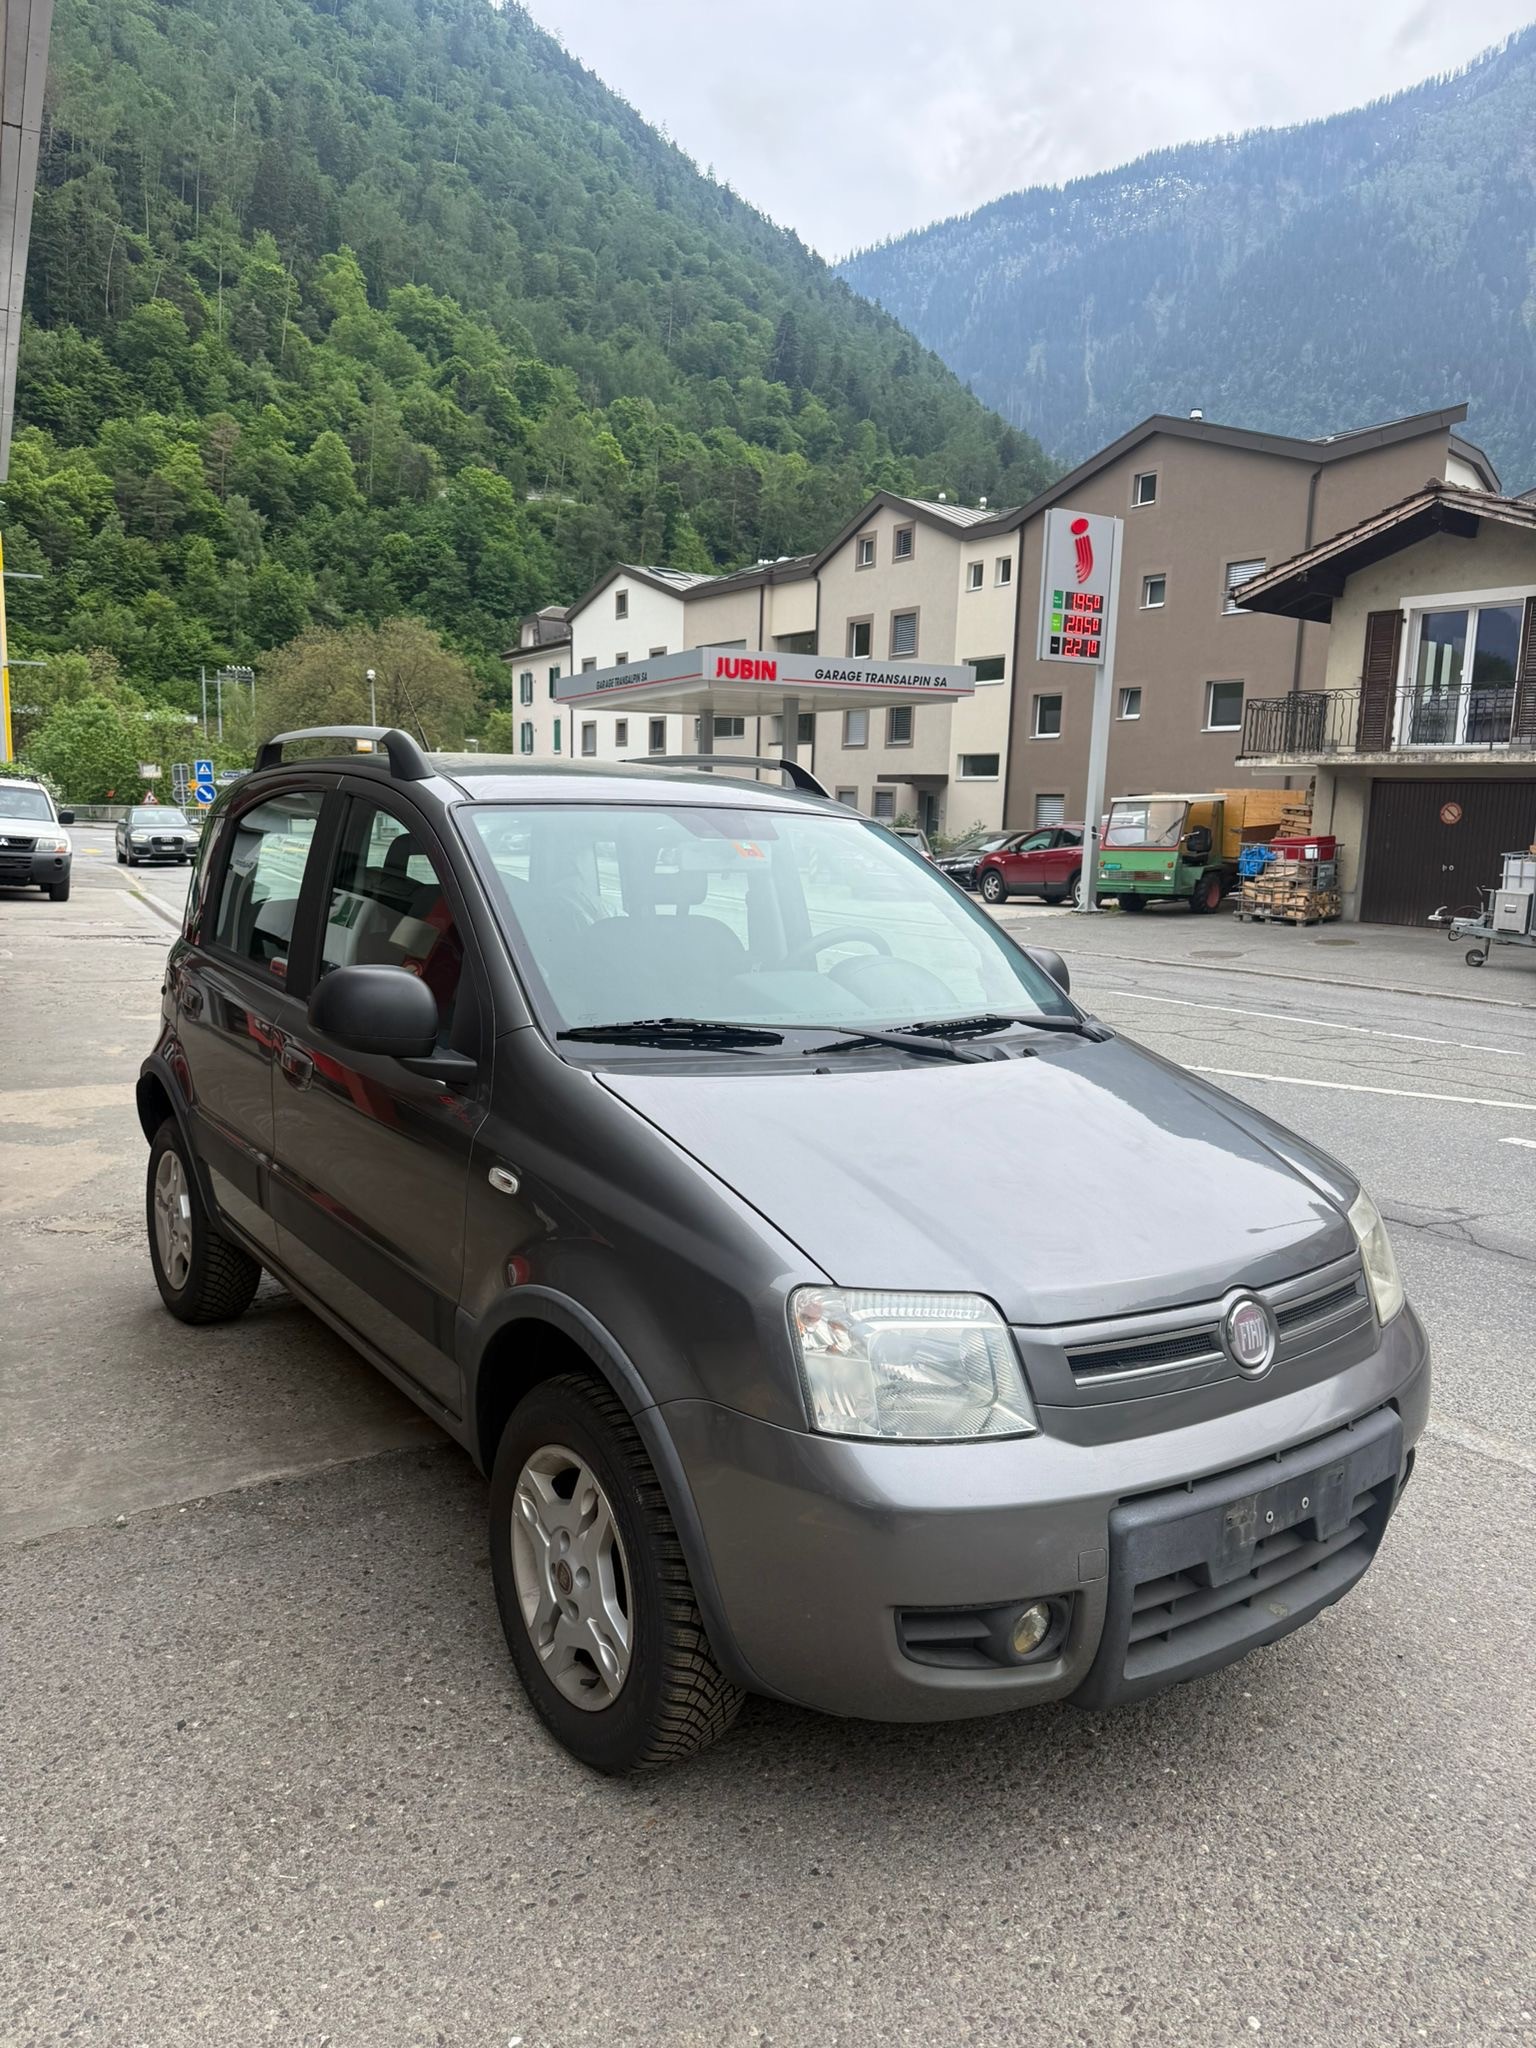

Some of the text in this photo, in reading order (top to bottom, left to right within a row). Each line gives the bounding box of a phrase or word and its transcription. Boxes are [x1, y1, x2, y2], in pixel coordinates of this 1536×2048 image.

[716, 656, 777, 681] JUBIN
[815, 669, 947, 687] GARAGE TRANSALPIN SA
[596, 671, 648, 690] GARAGE TRANSALPIN SA
[1239, 1317, 1263, 1352] FIAT
